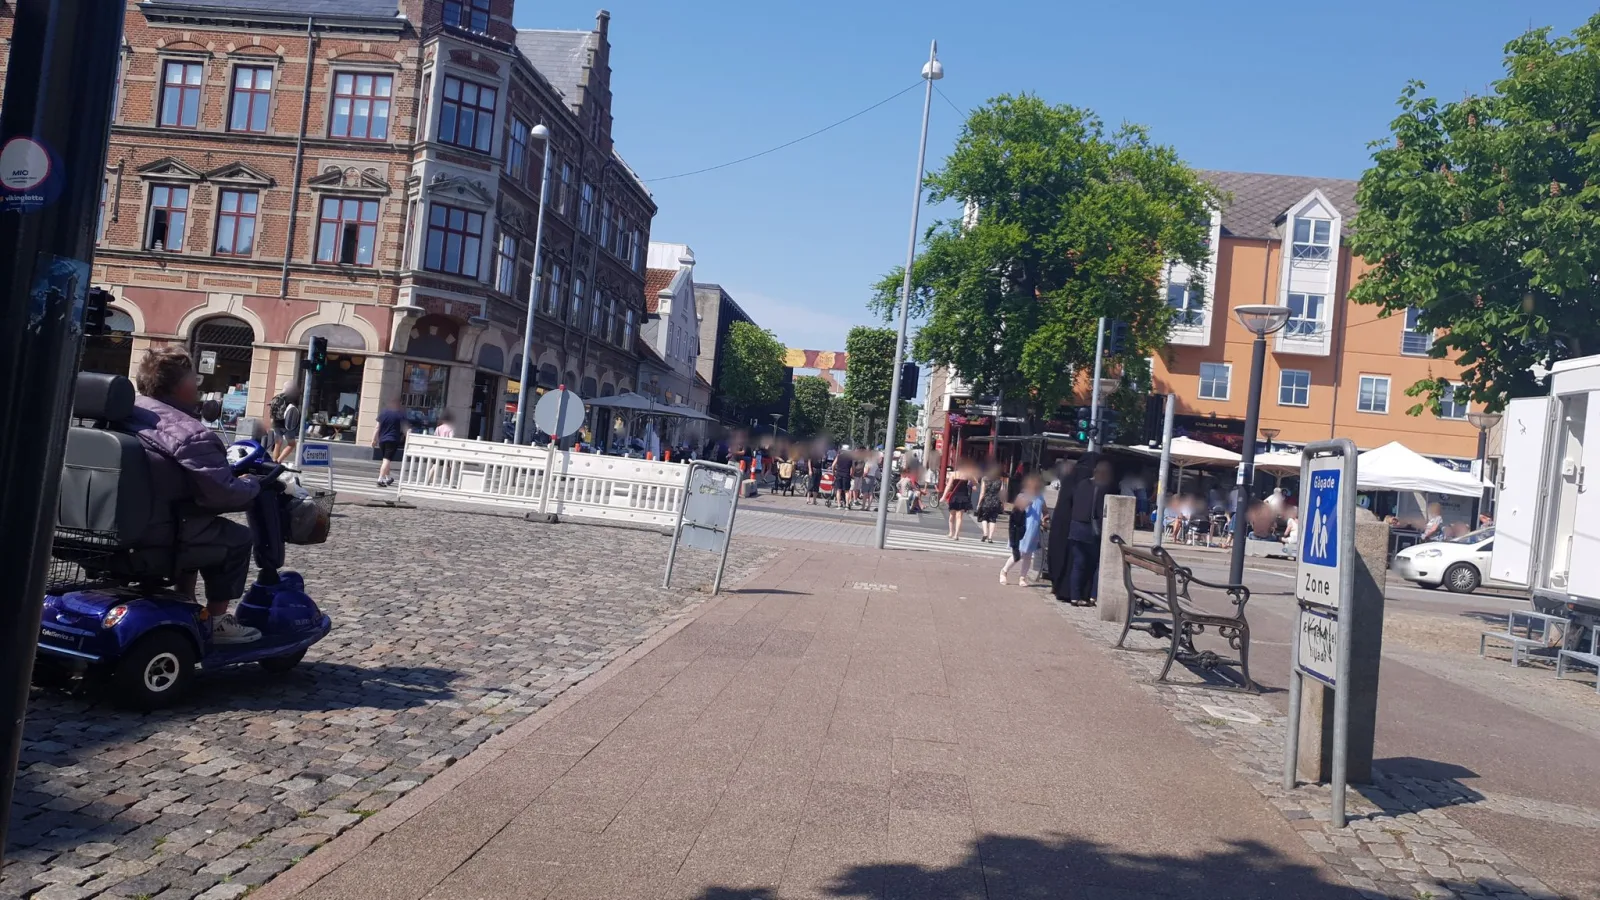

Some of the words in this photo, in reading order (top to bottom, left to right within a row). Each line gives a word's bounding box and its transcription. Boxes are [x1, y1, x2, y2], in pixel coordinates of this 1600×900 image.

[5, 194, 44, 203] vikinglotto
[306, 450, 327, 460] Ensrettet
[1313, 475, 1335, 491] Gågade
[1305, 572, 1330, 596] Zone
